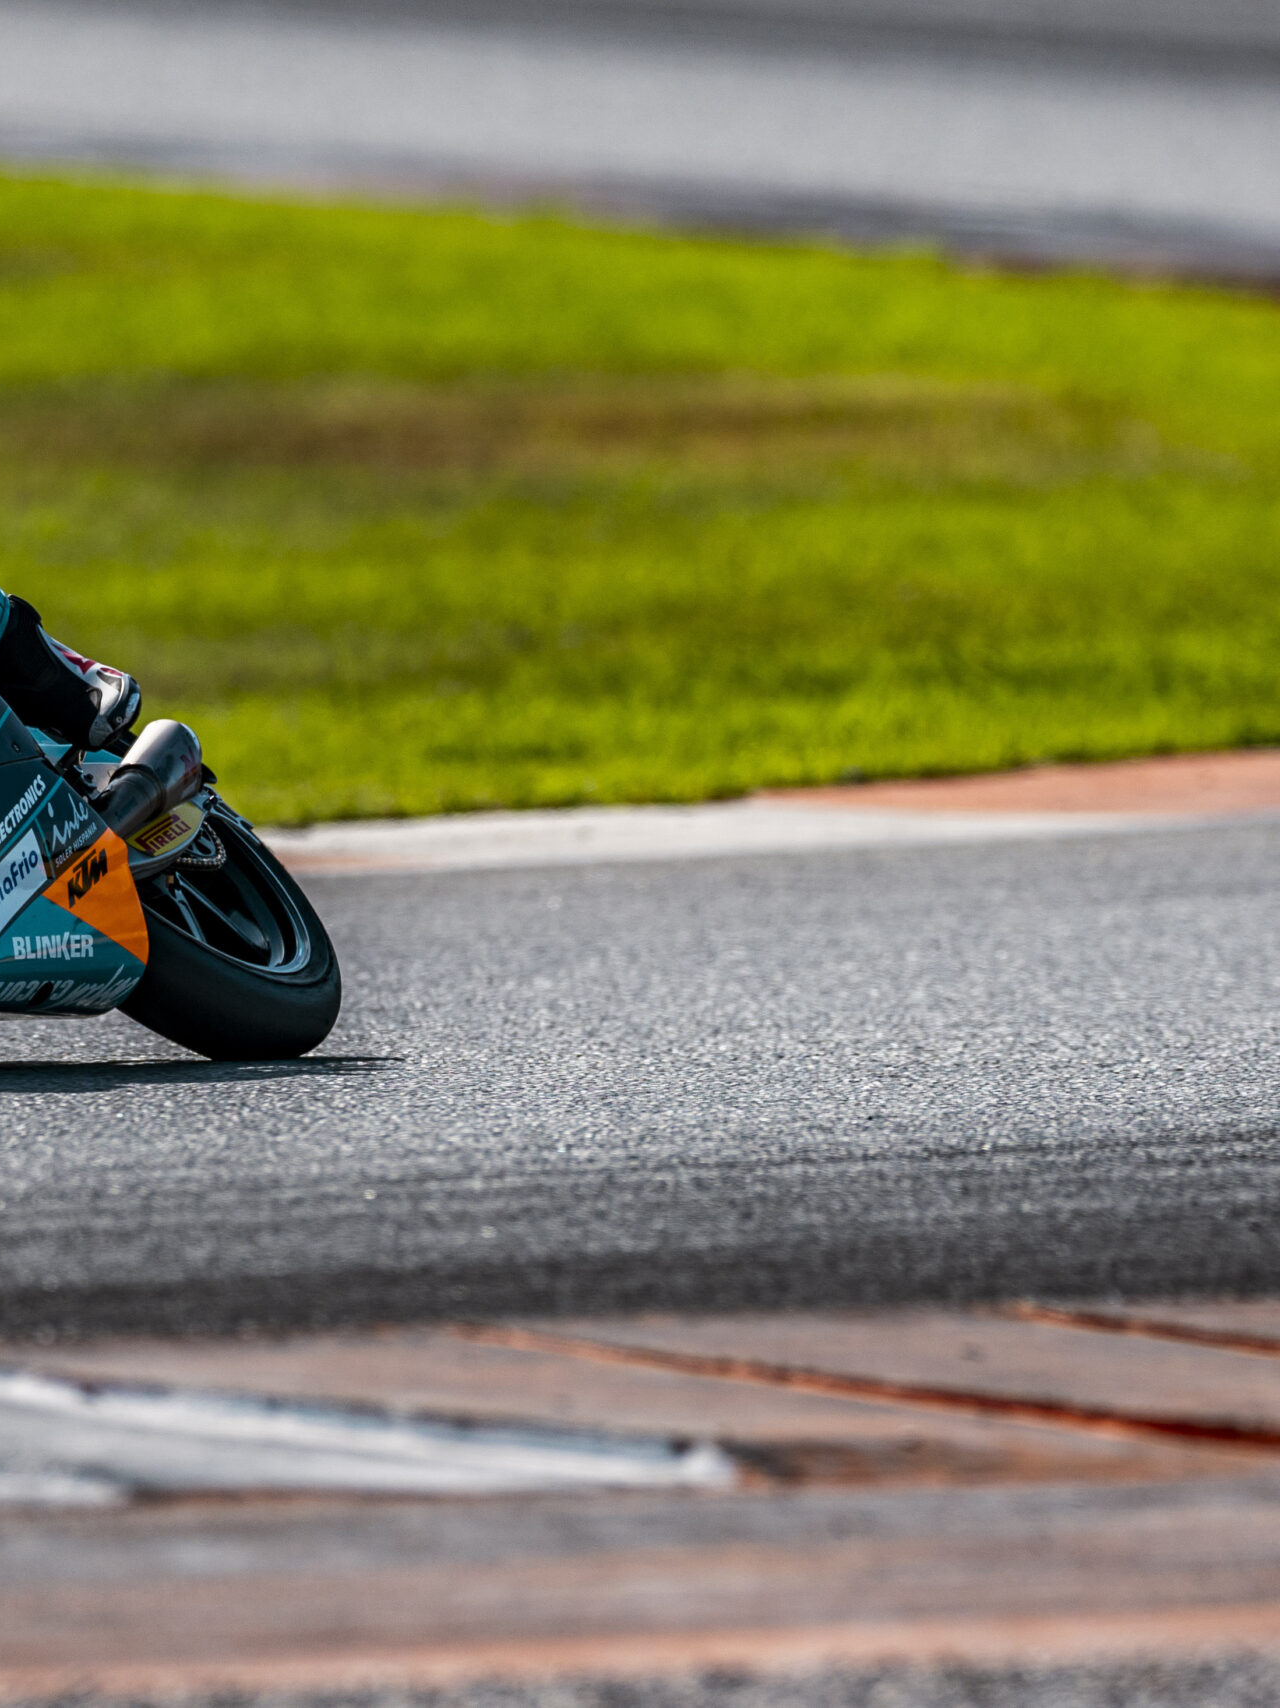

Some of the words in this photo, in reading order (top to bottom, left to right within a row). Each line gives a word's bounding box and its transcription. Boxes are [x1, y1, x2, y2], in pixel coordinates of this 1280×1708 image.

[135, 813, 192, 853] PIRELLI
[67, 847, 108, 909] KTM
[12, 931, 94, 961] BLINKER
